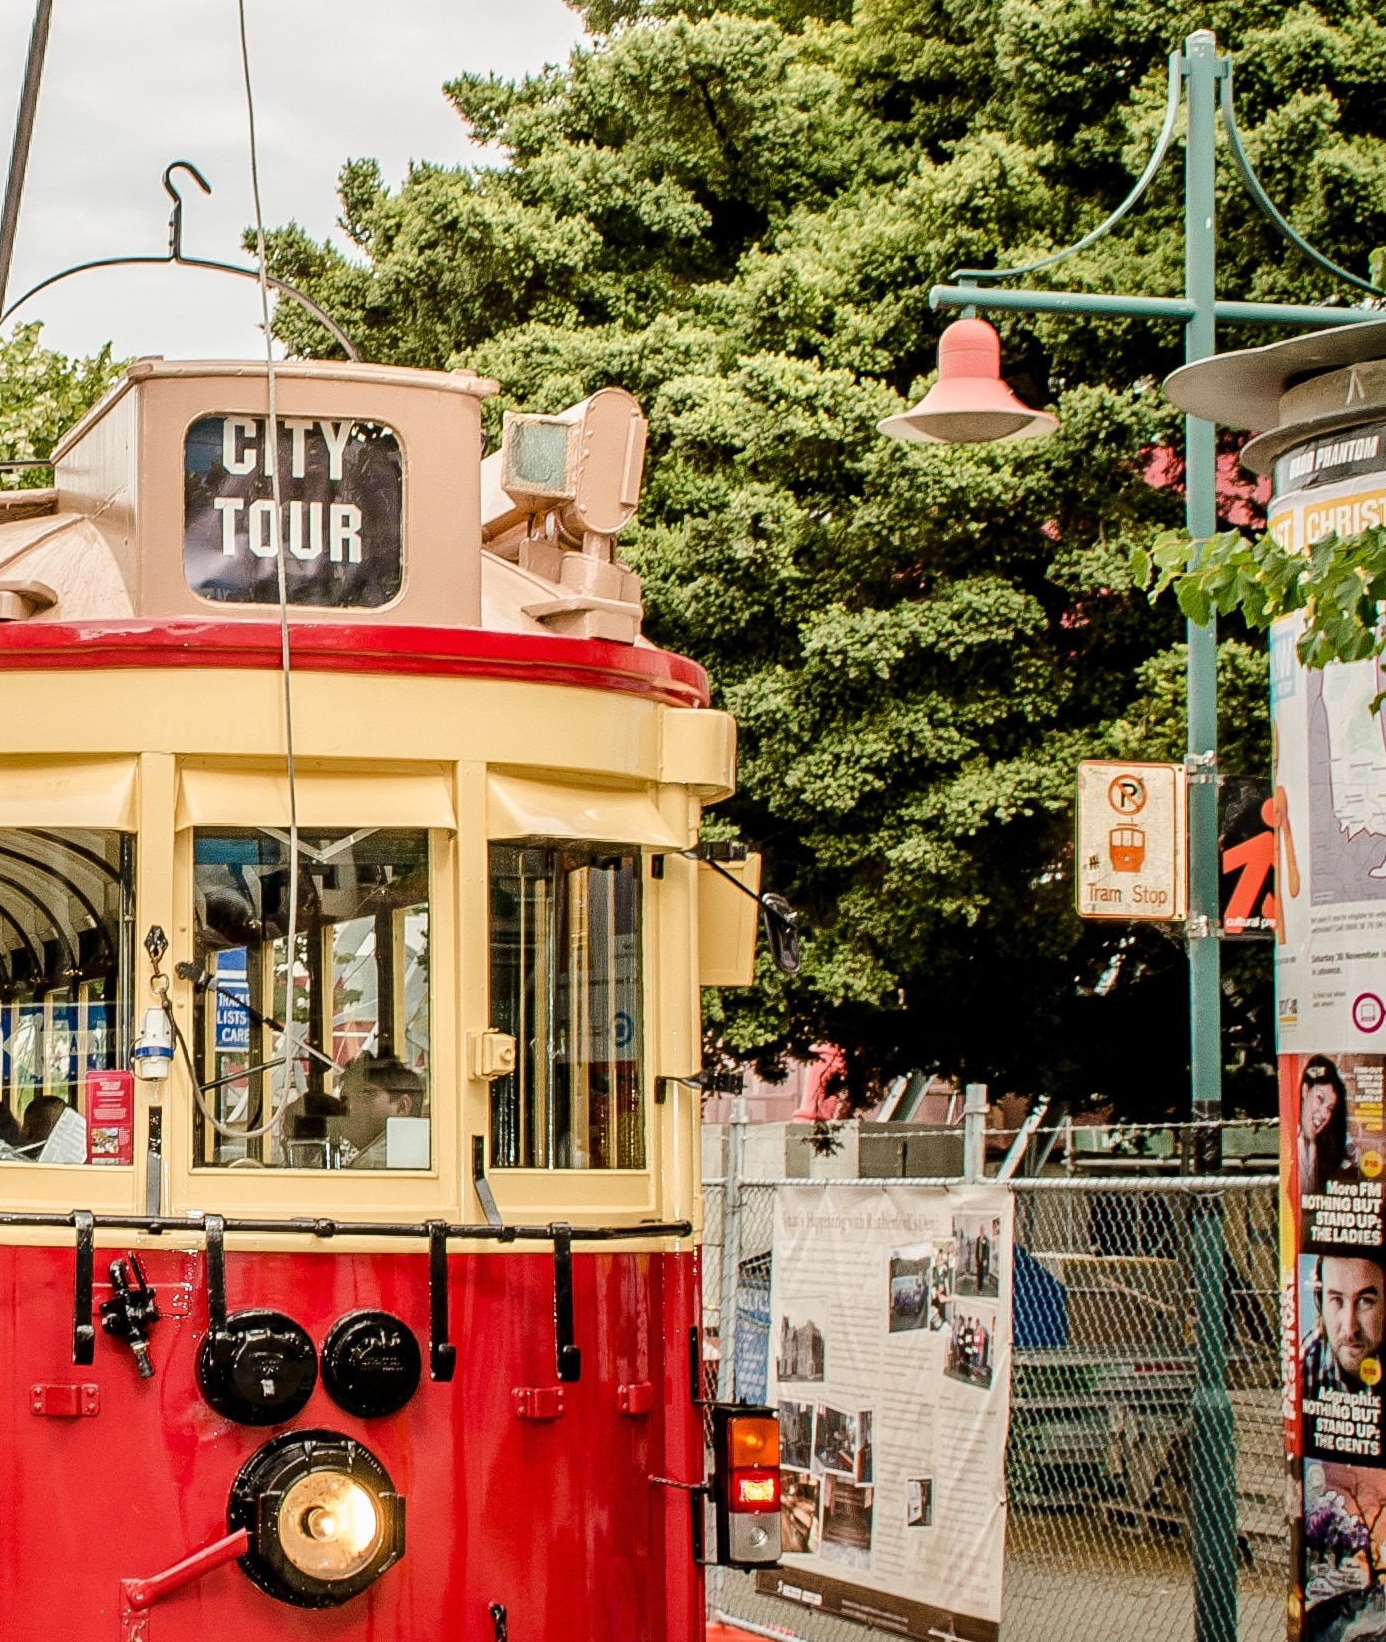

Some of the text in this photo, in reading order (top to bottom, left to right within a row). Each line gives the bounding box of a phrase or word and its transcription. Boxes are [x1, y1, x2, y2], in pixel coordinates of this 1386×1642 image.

[222, 417, 355, 480] CITY
[1315, 436, 1379, 471] PHANTOM
[214, 497, 362, 564] TOUR
[1087, 883, 1167, 905] Tram Stop
[217, 1010, 247, 1025] LISTS
[222, 1027, 250, 1043] CARE
[1326, 1179, 1382, 1197] More FM
[1301, 1194, 1383, 1213] NOTHING BUT
[1316, 1211, 1382, 1229] STAND UP:
[1310, 1225, 1383, 1246] THE LADIES
[1302, 1399, 1381, 1423] NOTHING BUT
[1316, 1417, 1381, 1439] STAND UP:
[1314, 1432, 1381, 1456] THE GENTS
